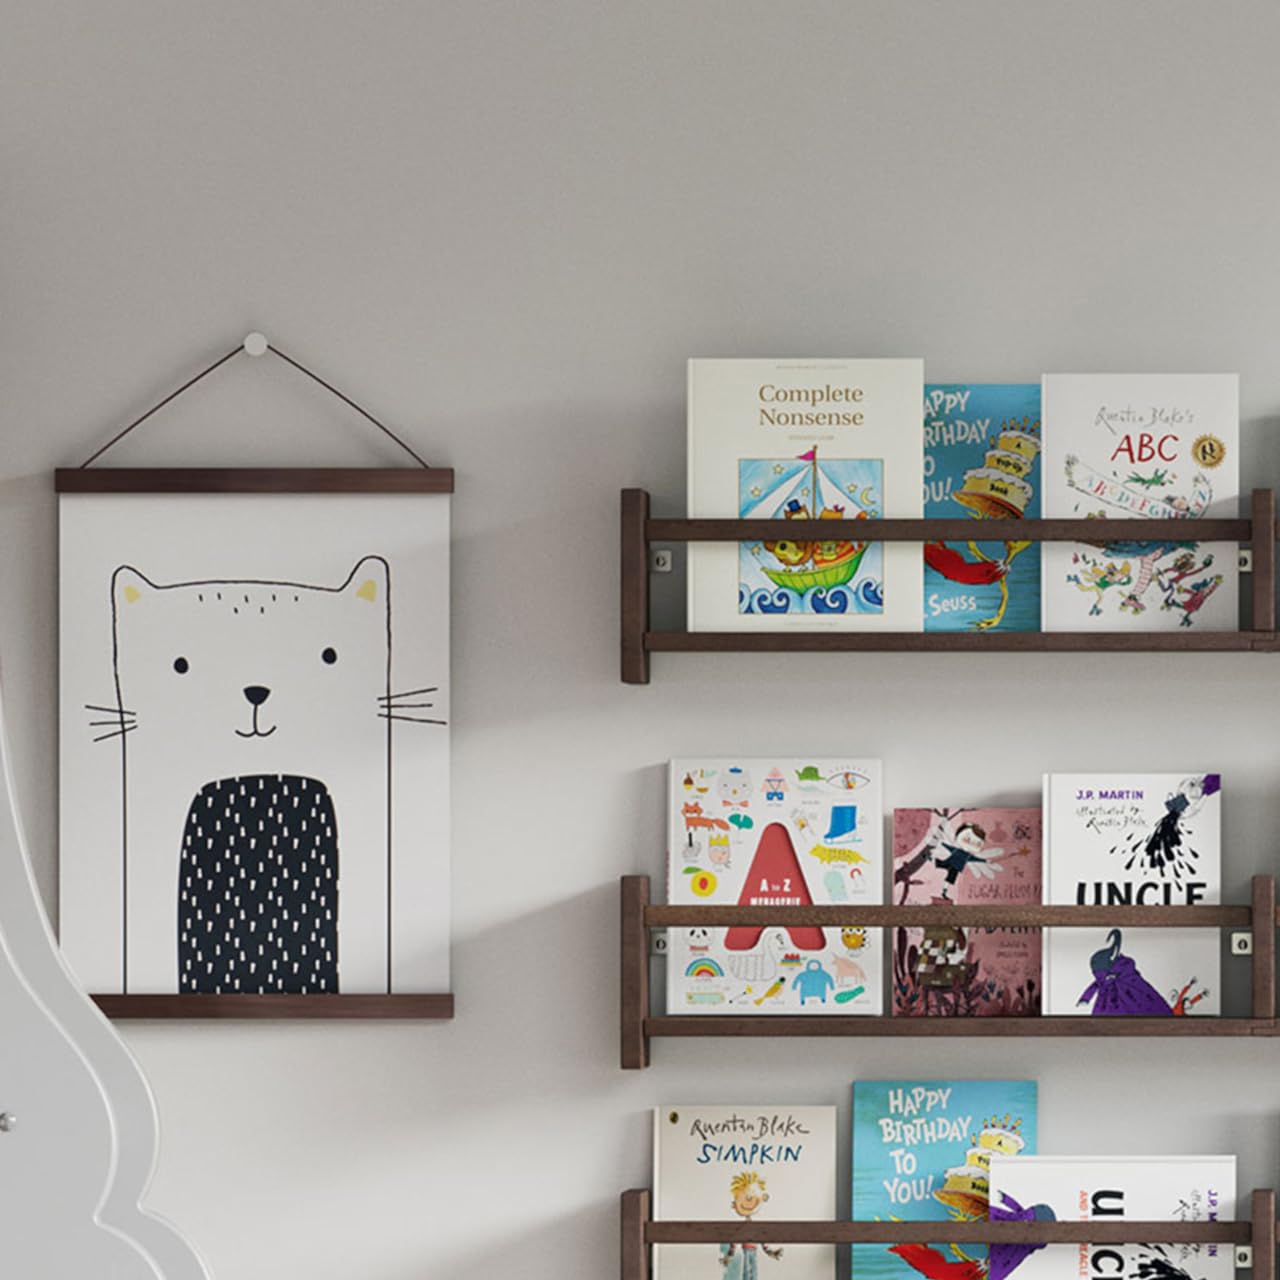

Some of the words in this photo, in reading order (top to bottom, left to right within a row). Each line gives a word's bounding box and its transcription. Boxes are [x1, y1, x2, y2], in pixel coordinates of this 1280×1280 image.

[759, 384, 864, 407] Complete
[923, 389, 971, 417] APPY
[759, 408, 864, 426] Nonsense
[923, 418, 991, 447] RTHDAY
[1110, 432, 1180, 464] ABC
[922, 476, 952, 504] OU!
[928, 593, 977, 617] Seuss
[1076, 790, 1095, 800] J.P.
[1098, 790, 1144, 800] MARTIN
[760, 878, 769, 892] A
[783, 878, 791, 892] Z
[1076, 882, 1208, 906] UNCLE
[887, 1087, 952, 1116] HAPPY
[758, 1115, 811, 1137] Blake
[878, 1116, 973, 1146] BIRTHDAY
[696, 1143, 803, 1166] SIMPKIN
[889, 1150, 917, 1175] TO
[883, 1174, 934, 1205] YOU!
